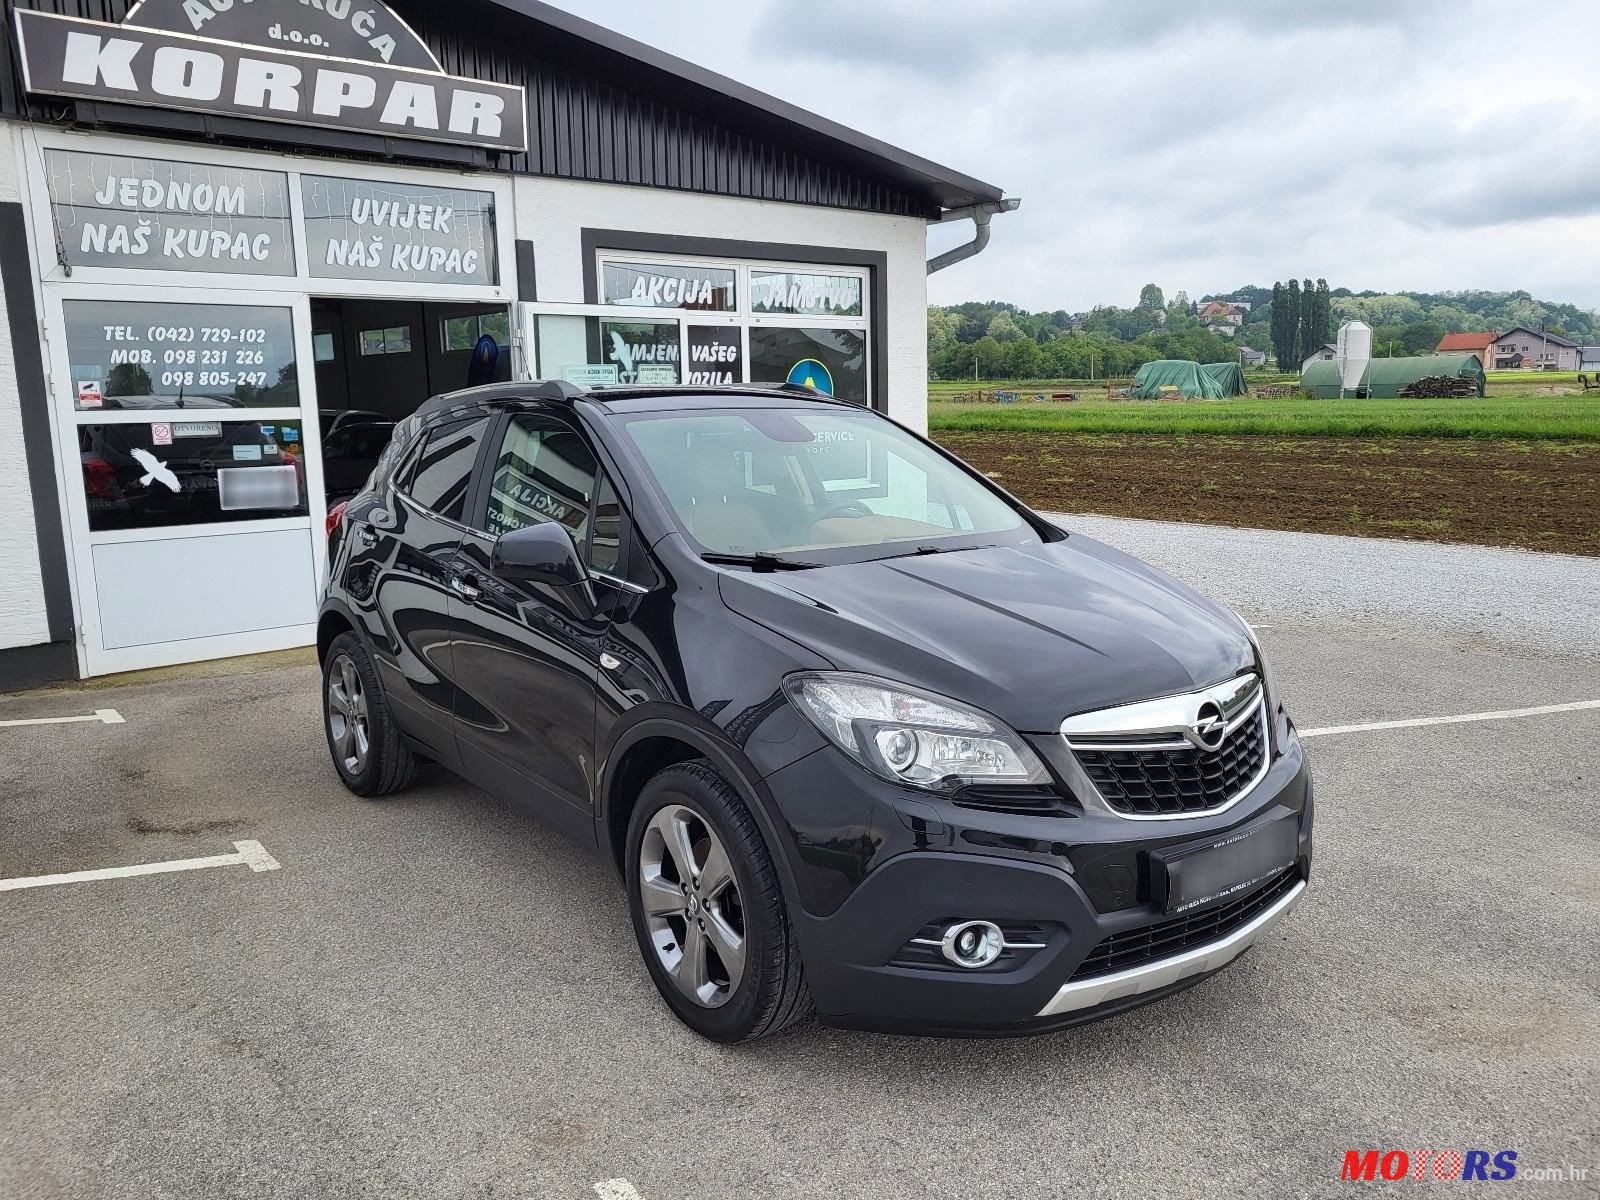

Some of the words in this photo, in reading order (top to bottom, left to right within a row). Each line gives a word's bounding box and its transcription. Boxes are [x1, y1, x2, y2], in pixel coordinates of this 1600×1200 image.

[268, 24, 330, 47] d.o.o.
[62, 31, 506, 138] KORPAR
[95, 175, 246, 215] JEDNOM
[351, 198, 453, 234] UVIJEK
[80, 218, 151, 255] NAŠ
[163, 227, 271, 261] KUPAC
[325, 235, 384, 268] NAŠ
[391, 243, 478, 274] KUPAC
[631, 275, 714, 306] AKCIJA
[763, 284, 854, 311] JAMSTVO
[103, 325, 140, 341] TEL.
[147, 326, 195, 342] (042)
[201, 327, 266, 343] 729-102
[110, 349, 157, 364] MOB.
[163, 349, 196, 365] 098
[201, 350, 228, 364] 231
[235, 350, 264, 365] 226
[691, 341, 737, 362] VAŠEG
[161, 371, 194, 386] 098
[199, 371, 267, 386] 805-247
